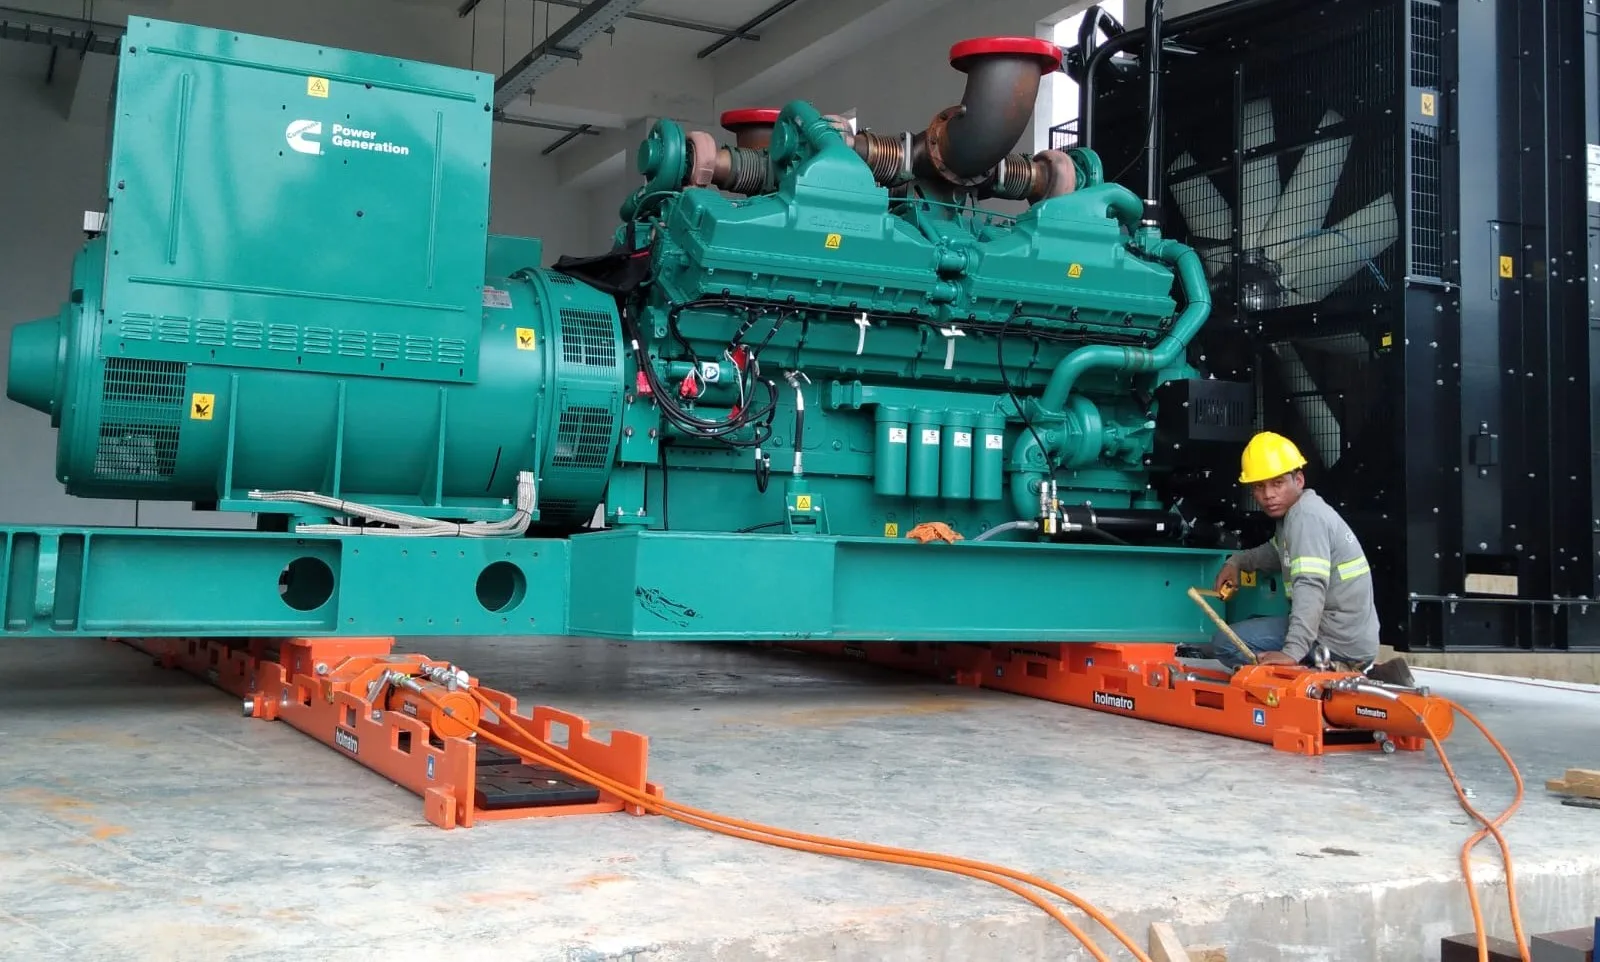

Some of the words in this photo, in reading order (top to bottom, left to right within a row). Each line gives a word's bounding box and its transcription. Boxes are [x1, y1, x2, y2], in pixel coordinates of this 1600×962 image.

[332, 123, 377, 140] Power
[332, 135, 410, 155] Generation
[1094, 691, 1134, 710] holmatro
[1356, 706, 1387, 719] holmatro
[336, 727, 358, 753] holmatro
